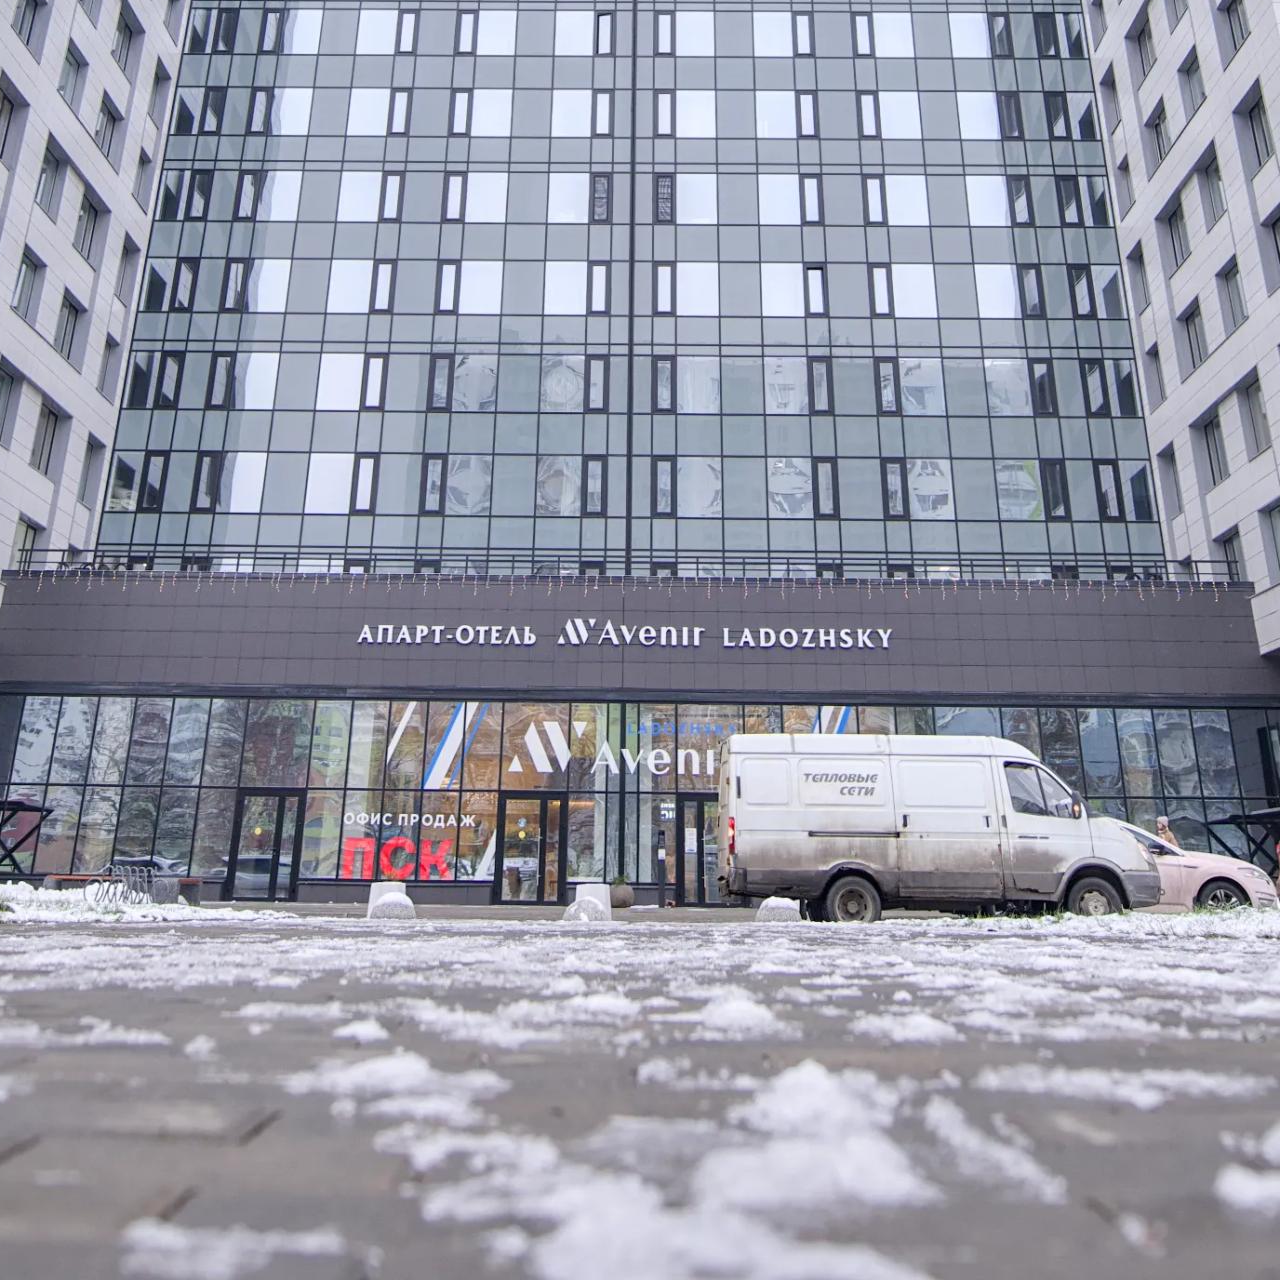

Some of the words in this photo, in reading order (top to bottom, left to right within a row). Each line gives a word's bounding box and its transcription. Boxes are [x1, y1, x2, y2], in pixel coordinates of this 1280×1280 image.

[357, 624, 538, 646] АПАРТ-ОТЕЛЬ
[723, 627, 893, 649] LADOZHSKY
[591, 740, 715, 776] Aveni
[344, 811, 393, 826] ОФИС
[398, 813, 477, 829] ПРОДАЖ
[341, 836, 454, 881] ПСК
